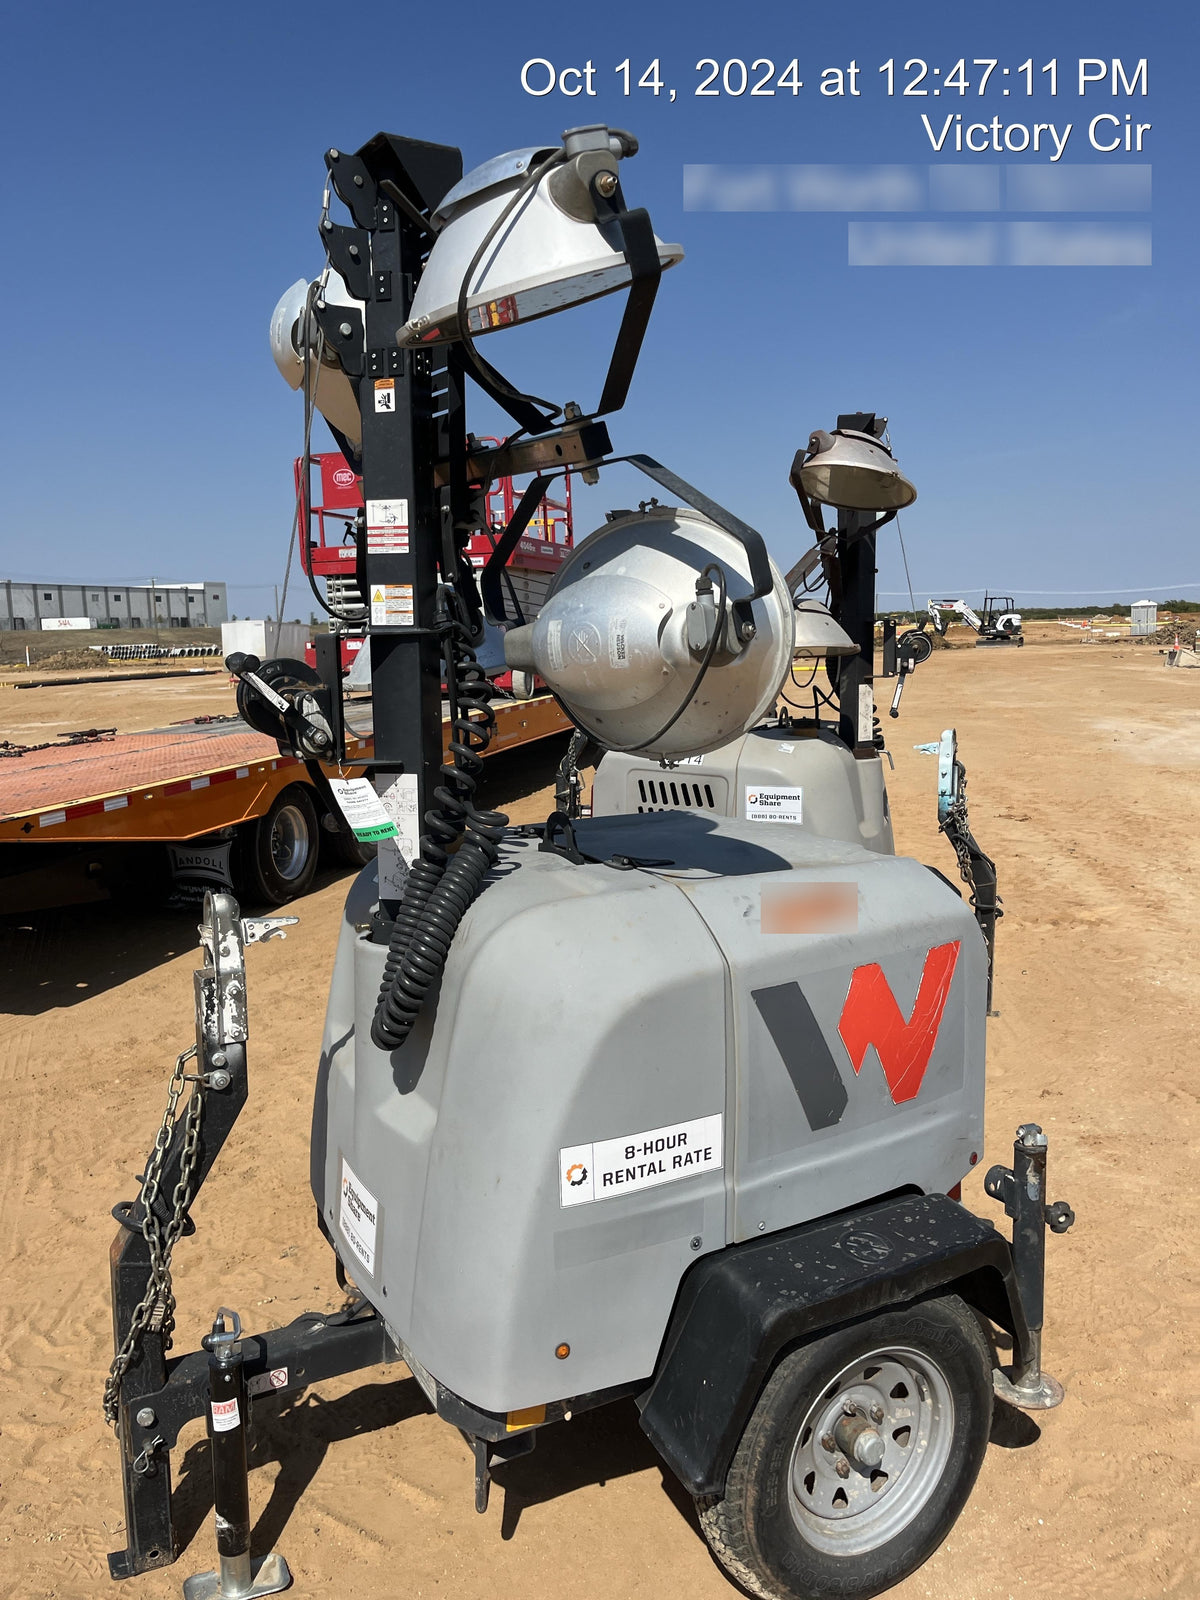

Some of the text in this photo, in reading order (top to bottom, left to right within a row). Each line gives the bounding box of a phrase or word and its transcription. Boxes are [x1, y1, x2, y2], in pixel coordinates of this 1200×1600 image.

[759, 793, 801, 801] Equipment
[381, 826, 395, 834] RENT
[624, 1132, 688, 1160] 8-HOUR
[603, 1146, 713, 1187] RENTAL RATE
[347, 1194, 361, 1222] Share
[348, 1181, 376, 1226] Equipment
